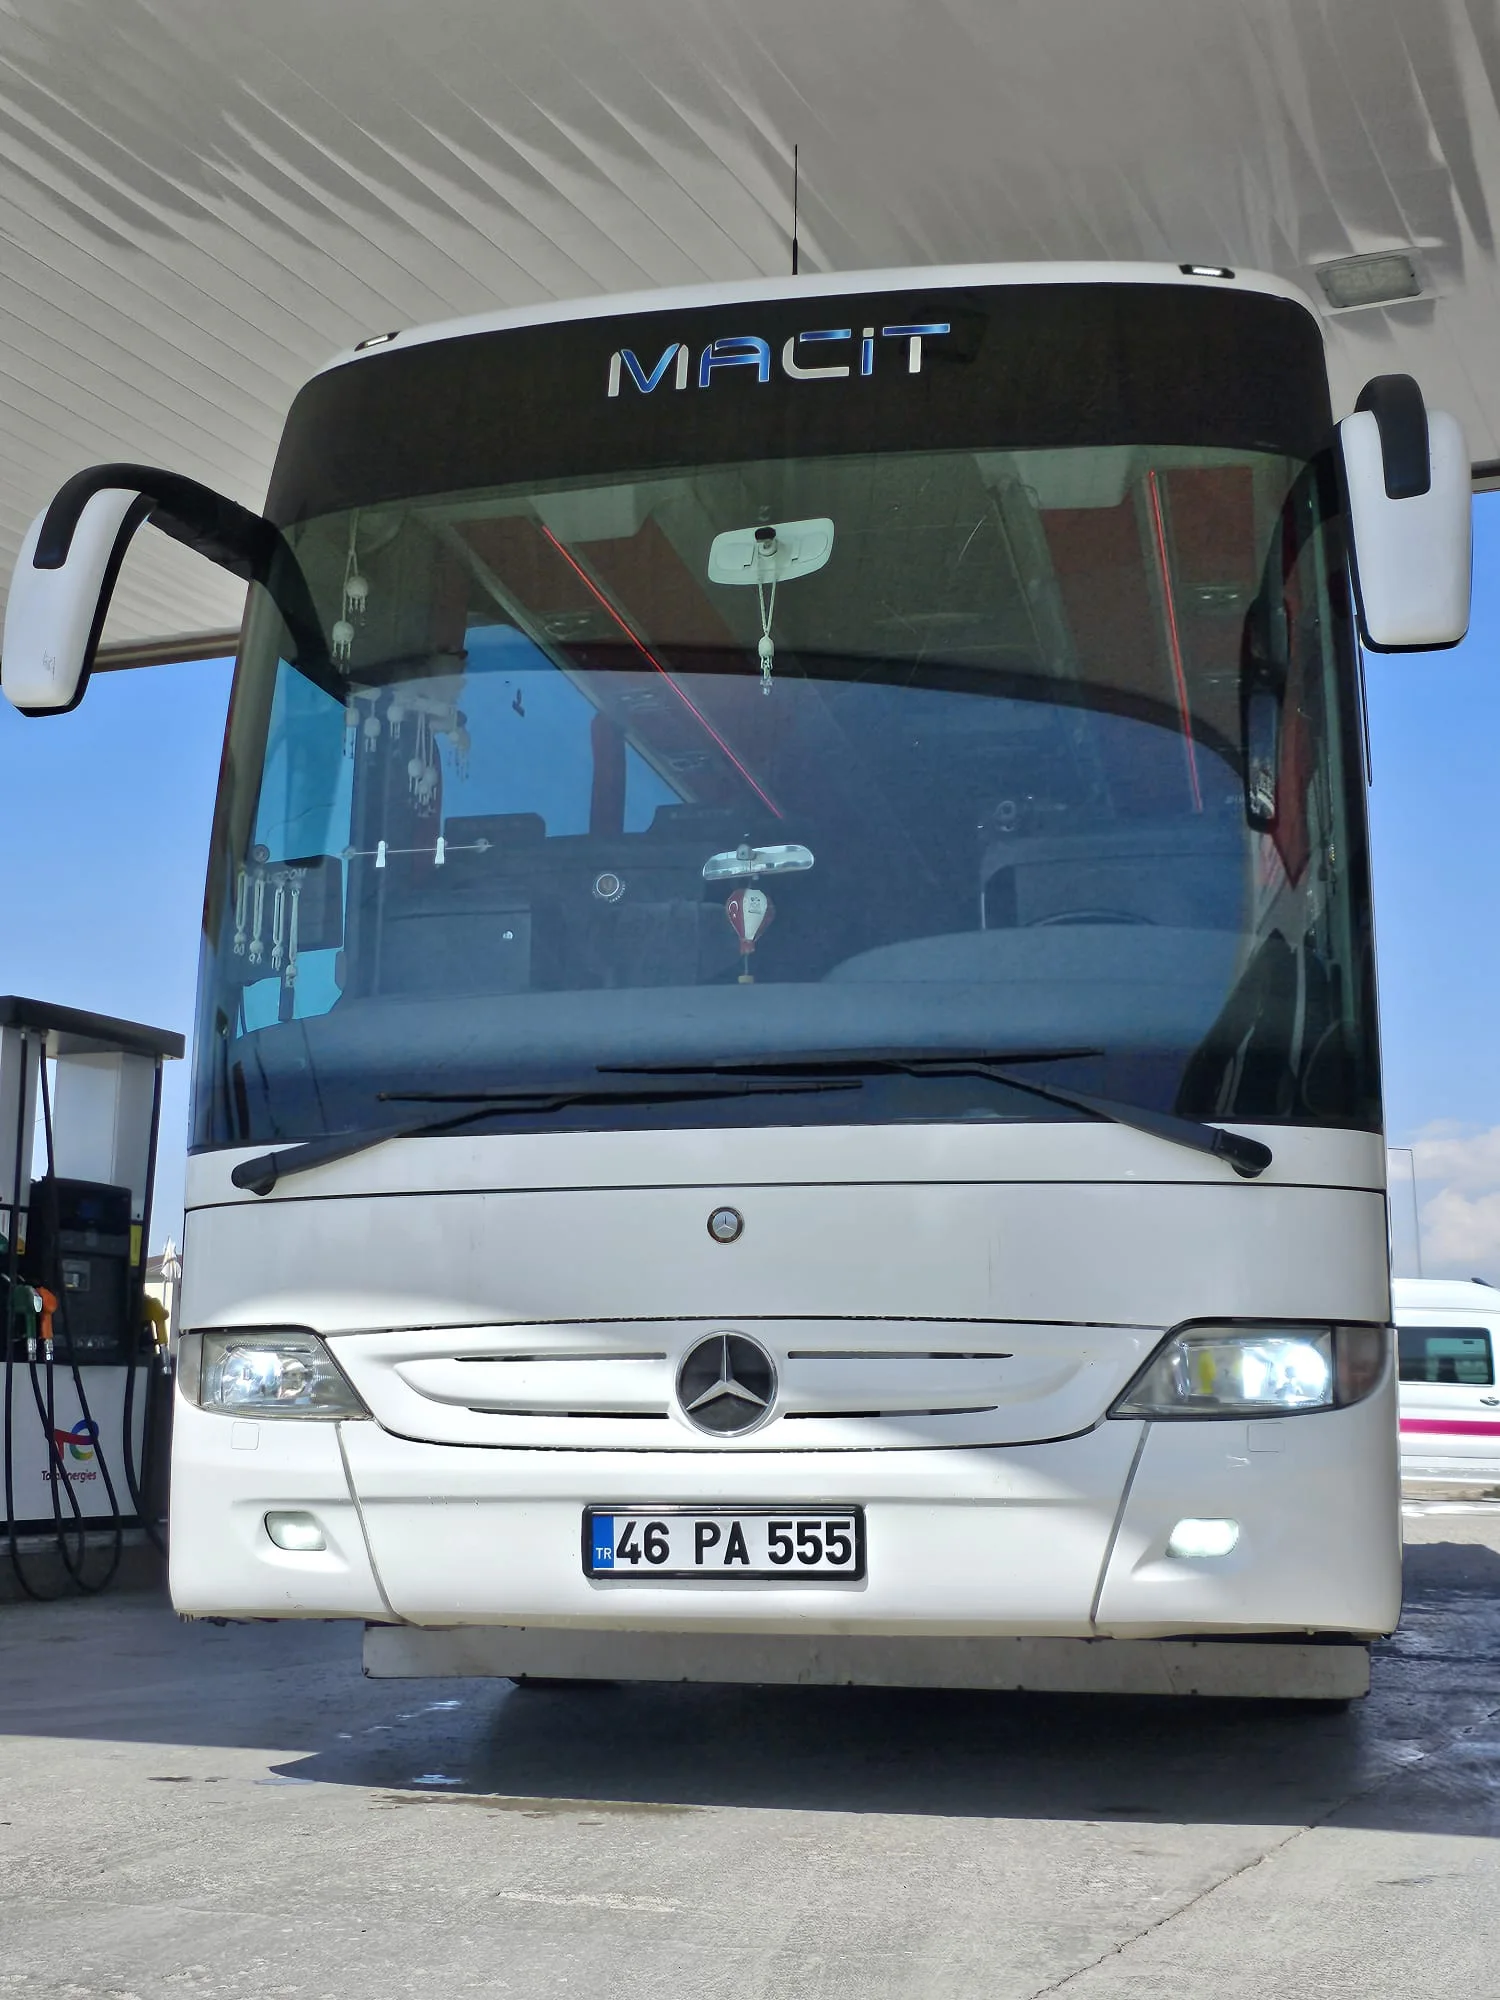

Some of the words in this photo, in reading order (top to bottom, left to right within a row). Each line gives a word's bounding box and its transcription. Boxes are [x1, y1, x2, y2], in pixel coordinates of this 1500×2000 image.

[595, 1547, 612, 1560] TR
[616, 1521, 670, 1565] 46
[694, 1521, 751, 1565] PA
[767, 1521, 852, 1565] 555
